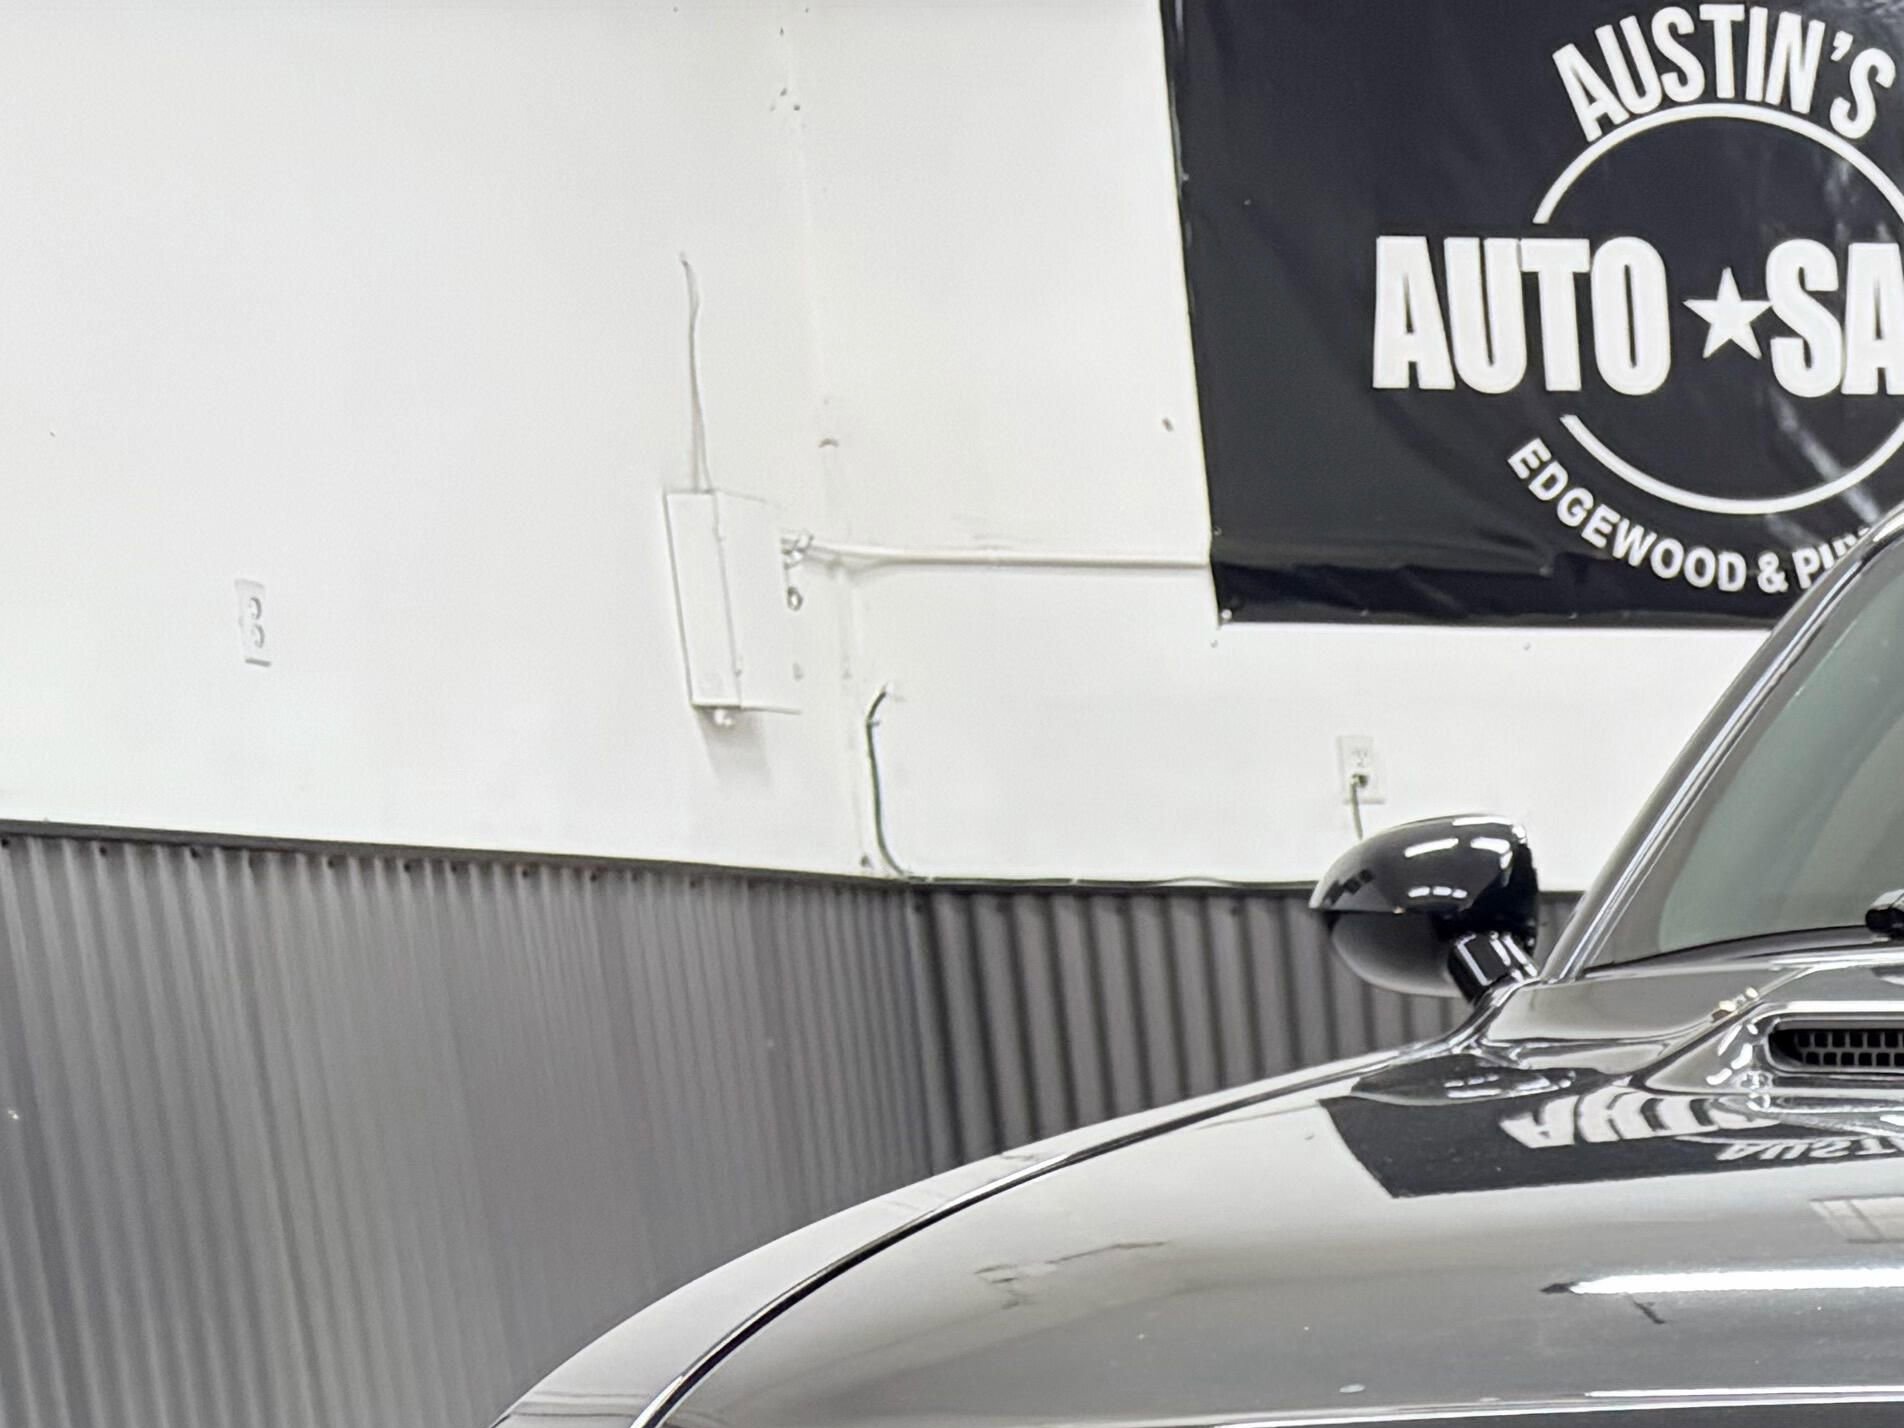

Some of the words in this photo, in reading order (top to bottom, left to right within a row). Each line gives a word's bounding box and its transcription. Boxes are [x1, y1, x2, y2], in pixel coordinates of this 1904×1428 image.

[1551, 3, 1895, 141] AUSTIN'S
[1373, 235, 1671, 396] AUTO
[1506, 437, 1746, 593] EDGEWOOD
[1757, 551, 1788, 593] &
